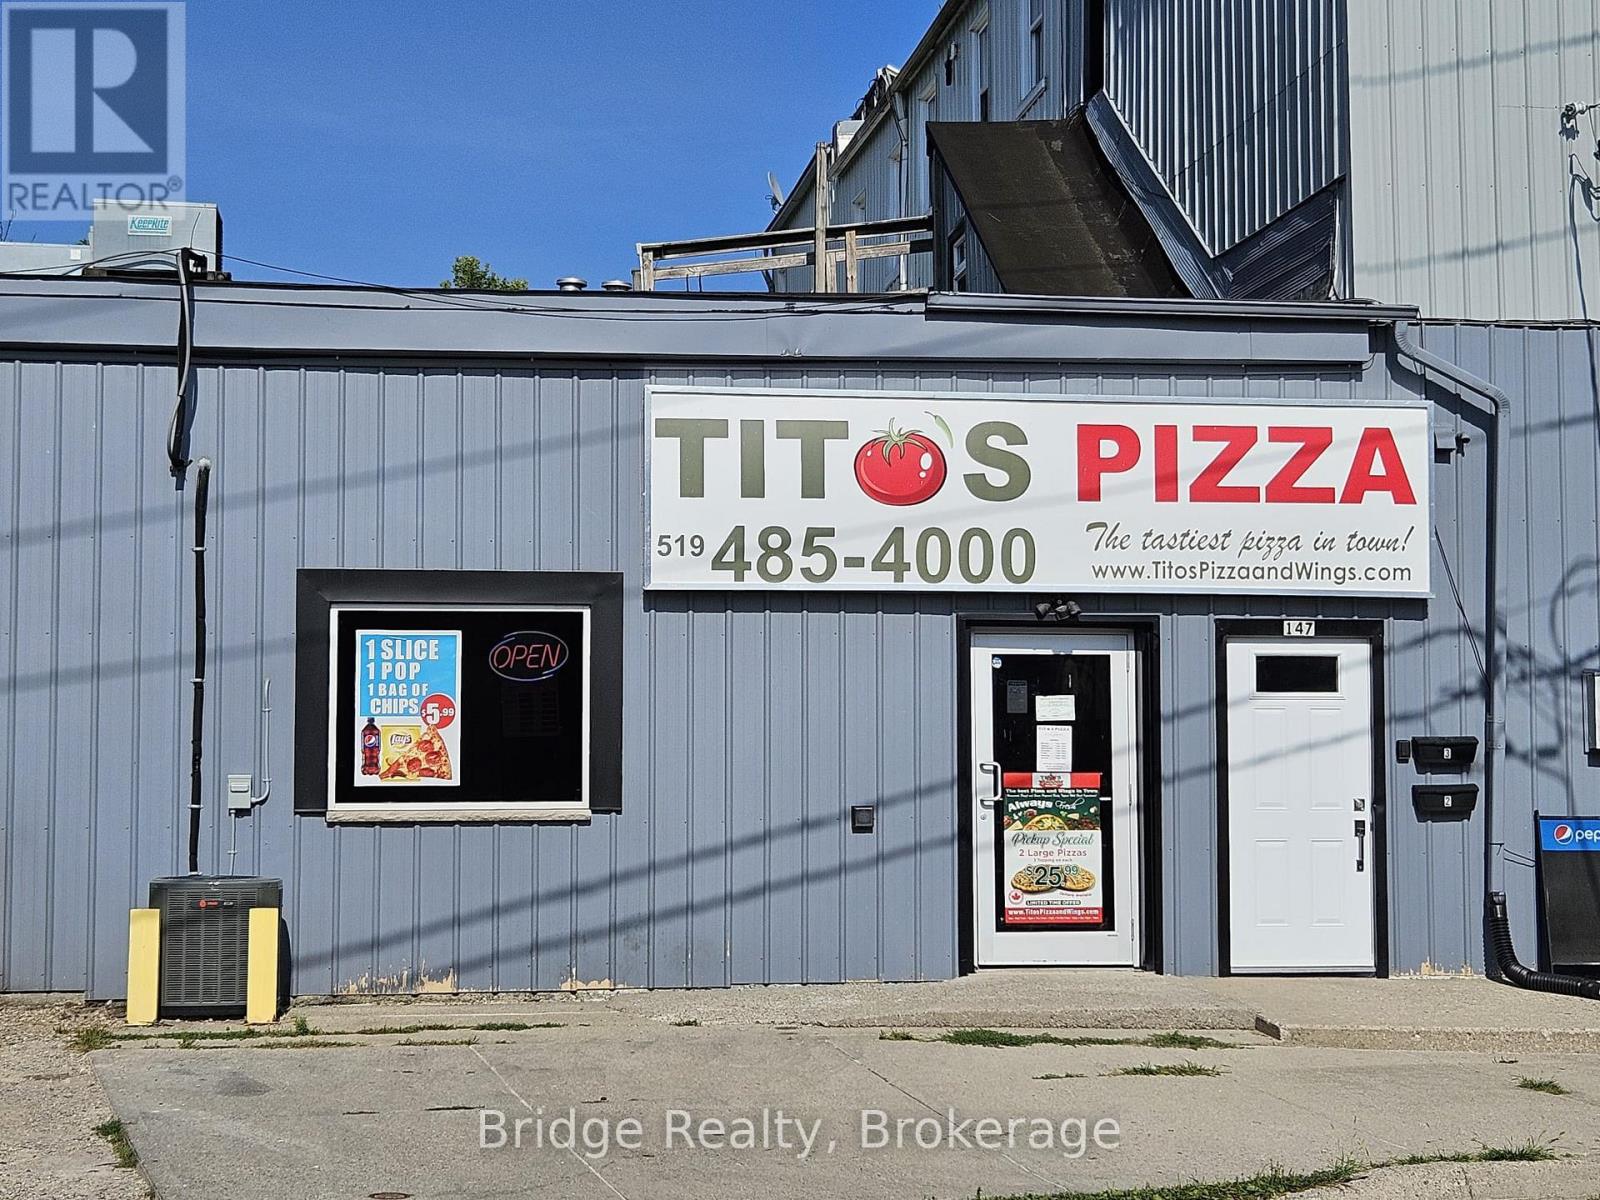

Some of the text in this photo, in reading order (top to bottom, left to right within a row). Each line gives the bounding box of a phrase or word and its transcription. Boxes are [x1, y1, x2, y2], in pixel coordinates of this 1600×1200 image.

[1076, 423, 1418, 505] PIZZA
[1086, 521, 1415, 561] The tastiest pizza in town!
[656, 525, 1037, 584] 519 485-4000
[1091, 560, 1412, 585] www.TitosPizzaandWings.com
[1285, 622, 1313, 635] 147
[365, 638, 439, 660] 1 SLICE
[492, 643, 561, 669] OPEN
[366, 661, 421, 680] 1 POP
[367, 683, 429, 696] 1 BAG OF
[370, 697, 419, 715] CHIPS
[421, 702, 455, 725] $5.99
[1444, 748, 1451, 758] 3
[1008, 799, 1053, 812] Always
[1445, 796, 1450, 806] 2
[1012, 831, 1094, 848] Pickup Special
[1019, 848, 1087, 858] 2 Large Pizzas
